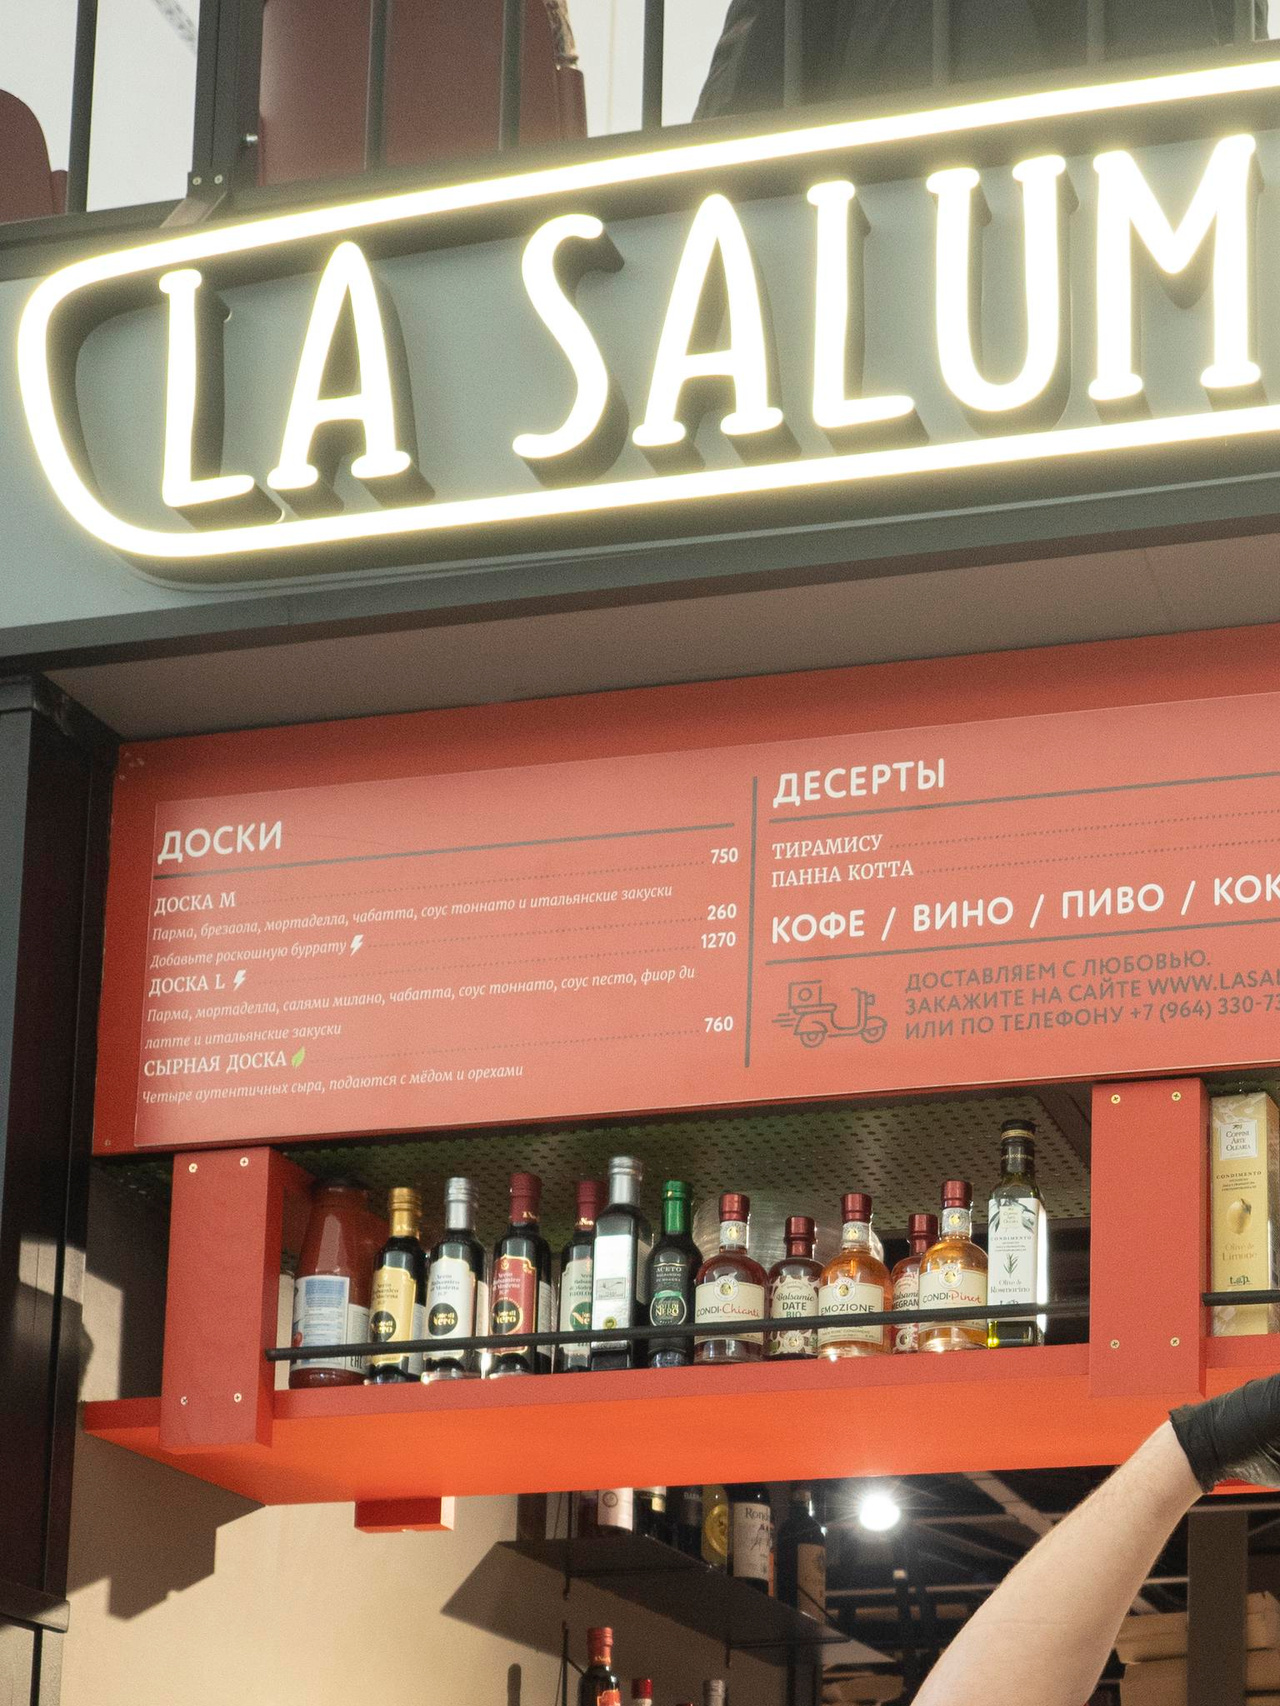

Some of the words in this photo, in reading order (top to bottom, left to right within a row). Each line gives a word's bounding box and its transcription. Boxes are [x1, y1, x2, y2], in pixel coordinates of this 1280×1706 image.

[158, 240, 411, 508] LA
[772, 758, 945, 808] ДЕСЕРТЫ
[157, 820, 282, 865] ДОСКИ
[771, 833, 883, 859] ТИРАМИСУ
[153, 893, 213, 917] ДОСКА
[710, 847, 738, 864] 750
[771, 866, 841, 888] ПАННА
[848, 859, 914, 881] КОТТА
[152, 927, 197, 942] Парма,
[200, 922, 261, 938] брезаола,
[264, 913, 349, 932] мортаделла,
[352, 907, 418, 923] чабатта,
[420, 905, 448, 919] соус
[451, 899, 516, 914] тоннато
[518, 898, 527, 909] и
[529, 890, 618, 908] итальянские
[621, 886, 672, 901] закуски
[772, 909, 865, 944] КОФЕ
[913, 896, 1014, 932] ВИНО
[1062, 883, 1164, 919] ПИВО
[149, 952, 213, 970] Добавьте
[215, 946, 289, 965] роскошную
[290, 941, 347, 959] буррату
[707, 903, 737, 921] 260
[148, 975, 209, 997] ДОСКА
[701, 931, 736, 948] 1270
[905, 963, 1055, 993] ДОСТАВЛЯЕМ
[1062, 960, 1075, 977] С
[1082, 949, 1210, 976] ЛЮБОВЬЮ.
[146, 1008, 192, 1023] Парма,
[195, 1001, 279, 1019] мортаделла,
[282, 998, 329, 1011] салями
[332, 993, 386, 1007] милано,
[389, 987, 455, 1002] чабатта,
[458, 984, 486, 999] соус
[488, 979, 558, 994] тоннато,
[560, 976, 588, 991] соус
[591, 972, 637, 986] песто,
[640, 968, 676, 986] фиор
[678, 964, 695, 979] ди
[906, 989, 1023, 1016] ЗАКАЖИТЕ
[1032, 986, 1061, 1002] НА
[1069, 978, 1139, 1002] САЙТЕ
[144, 1036, 191, 1050] латте
[193, 1036, 201, 1045] и
[204, 1028, 290, 1045] итальянские
[292, 1024, 342, 1039] закуски
[905, 1020, 953, 1039] ИЛИ
[961, 1016, 994, 1034] ПО
[1000, 1006, 1123, 1031] ТЕЛЕФОНУ
[1130, 1007, 1153, 1023] +7
[1159, 1000, 1212, 1025] (964)
[143, 1055, 220, 1077] СЫРНАЯ
[226, 1050, 287, 1073] ДОСКА
[704, 1015, 734, 1032] 760
[142, 1090, 192, 1104] Четыре
[194, 1083, 289, 1103] аутентичных
[290, 1080, 325, 1095] сыра,
[329, 1075, 397, 1090] подаются
[399, 1074, 406, 1084] с
[408, 1068, 453, 1084] мёдом
[456, 1070, 464, 1081] и
[467, 1065, 523, 1082] орехами
[782, 1302, 807, 1311] DATE
[820, 1303, 876, 1316] EMOZIONE
